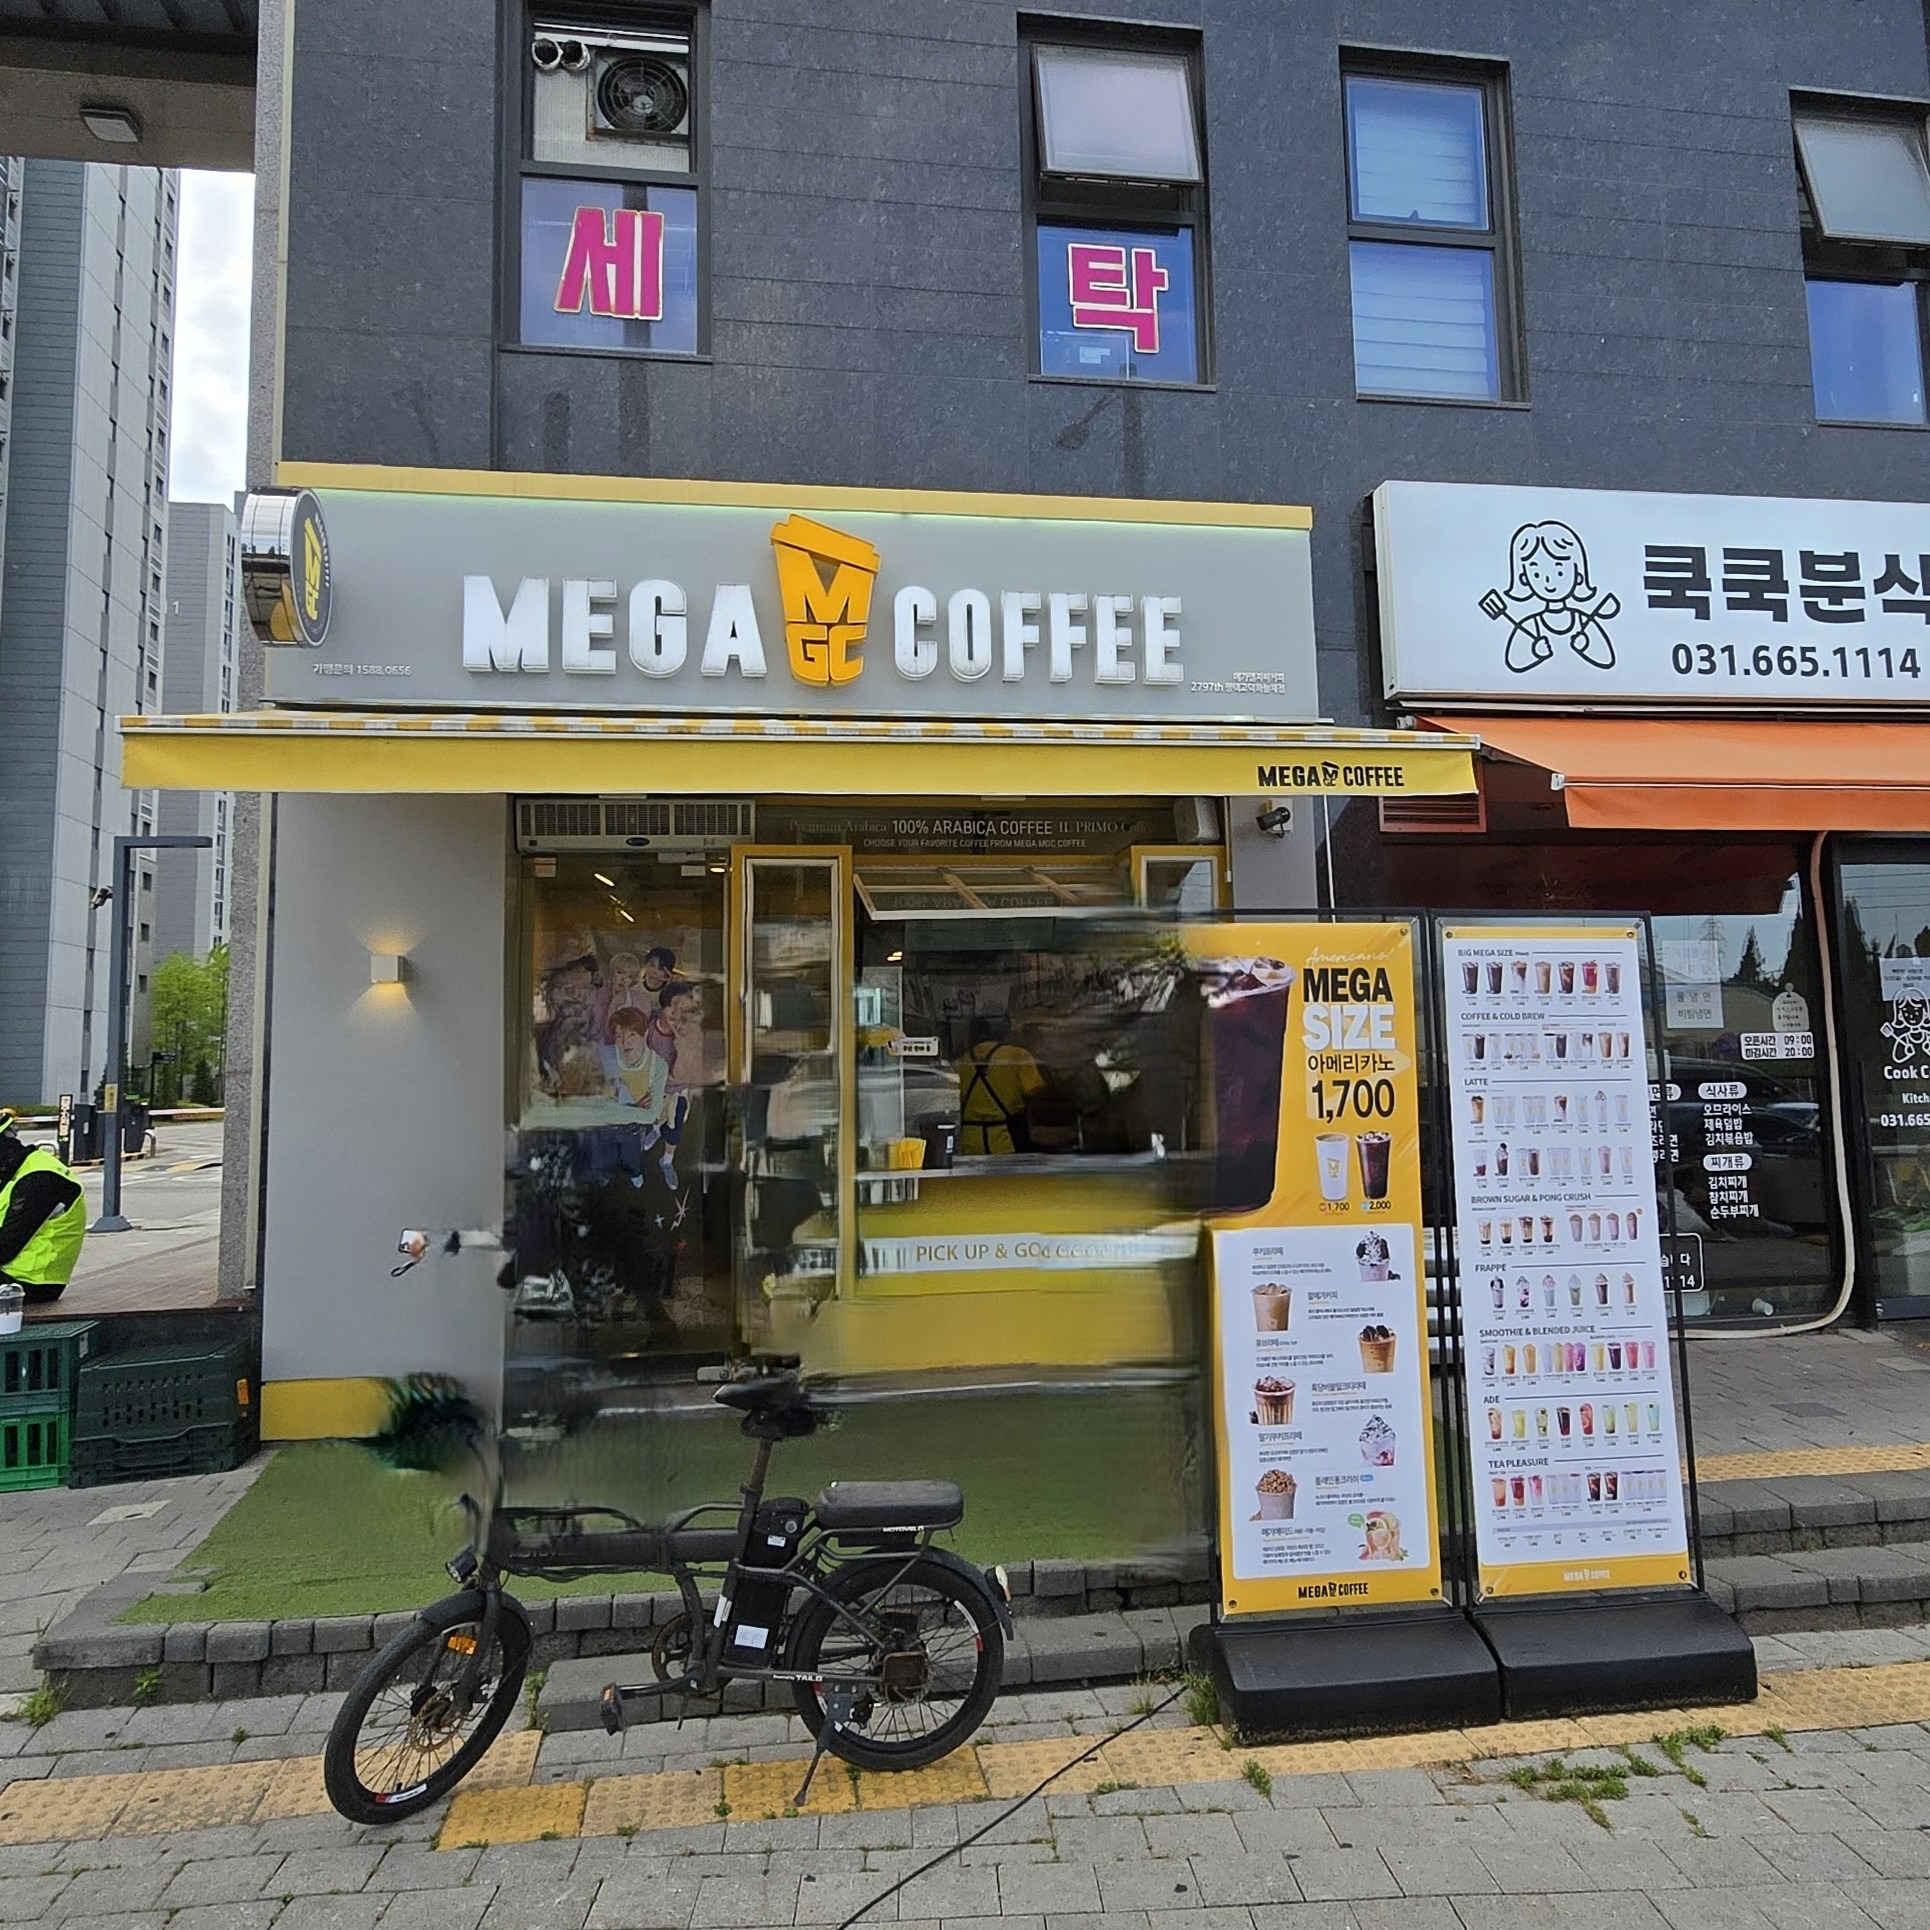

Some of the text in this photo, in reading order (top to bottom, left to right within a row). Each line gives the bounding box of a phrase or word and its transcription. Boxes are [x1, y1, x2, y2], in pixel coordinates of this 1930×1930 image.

[554, 206, 664, 320] 세
[1067, 242, 1169, 354] 탁
[463, 575, 1185, 685] MEGA COFFEE
[1672, 643, 1921, 679] 031.665.1114
[312, 663, 412, 676] 가맹문의 1588.0656
[1191, 682, 1224, 692] 2797th
[1258, 766, 1405, 787] MEGA COFFEE
[892, 820, 929, 835] 100%
[932, 820, 997, 836] ARABICA
[1000, 820, 1053, 835] COFFEE
[1076, 821, 1118, 833] PRIMO
[864, 838, 896, 847] CHOOSE
[898, 838, 919, 847] YOUR
[921, 838, 957, 848] FAVORITE
[959, 839, 989, 848] COFFEE
[990, 839, 1012, 848] FROM
[1014, 839, 1037, 848] MEGA
[1057, 839, 1087, 848] COFFEE
[1458, 949, 1472, 957] BIG
[1473, 949, 1495, 957] MEGA
[1497, 949, 1513, 957] SIZE
[1303, 967, 1394, 1003] MEGA
[1461, 1012, 1545, 1021] COFFEE & COLD BREW
[1302, 1003, 1395, 1050] SIZE
[1744, 1035, 1776, 1047] 오픈시간
[1745, 1047, 1777, 1058] 마감시간
[1307, 1053, 1395, 1073] 아메리카노
[1884, 1065, 1919, 1079] Cook
[1464, 1078, 1489, 1086] LATTE
[1706, 1085, 1740, 1097] 식사류
[1312, 1078, 1395, 1123] 1,700
[1703, 1103, 1752, 1116] 오므라이스
[1704, 1118, 1743, 1131] 제육덮밥
[1705, 1131, 1754, 1147] 김치볶음밥
[1711, 1155, 1744, 1168] 찌개류
[1708, 1175, 1748, 1190] 김치찌개
[1471, 1193, 1592, 1204] BROWN SUGAR & PONG CRUSH
[1708, 1190, 1749, 1205] 참치찌개
[1328, 1202, 1350, 1213] 1,700
[1710, 1204, 1760, 1219] 순두부찌개
[916, 1245, 958, 1262] PICK
[965, 1244, 989, 1260] UP
[995, 1243, 1008, 1259] &
[1475, 1264, 1507, 1272] FRAPPE
[1479, 1326, 1596, 1337] SMOOTHIE & BLENDED JUICE
[1483, 1395, 1500, 1404] ADE
[1488, 1458, 1549, 1469] TEA PLEASURE
[1298, 1583, 1369, 1599] MEGA COFFEE
